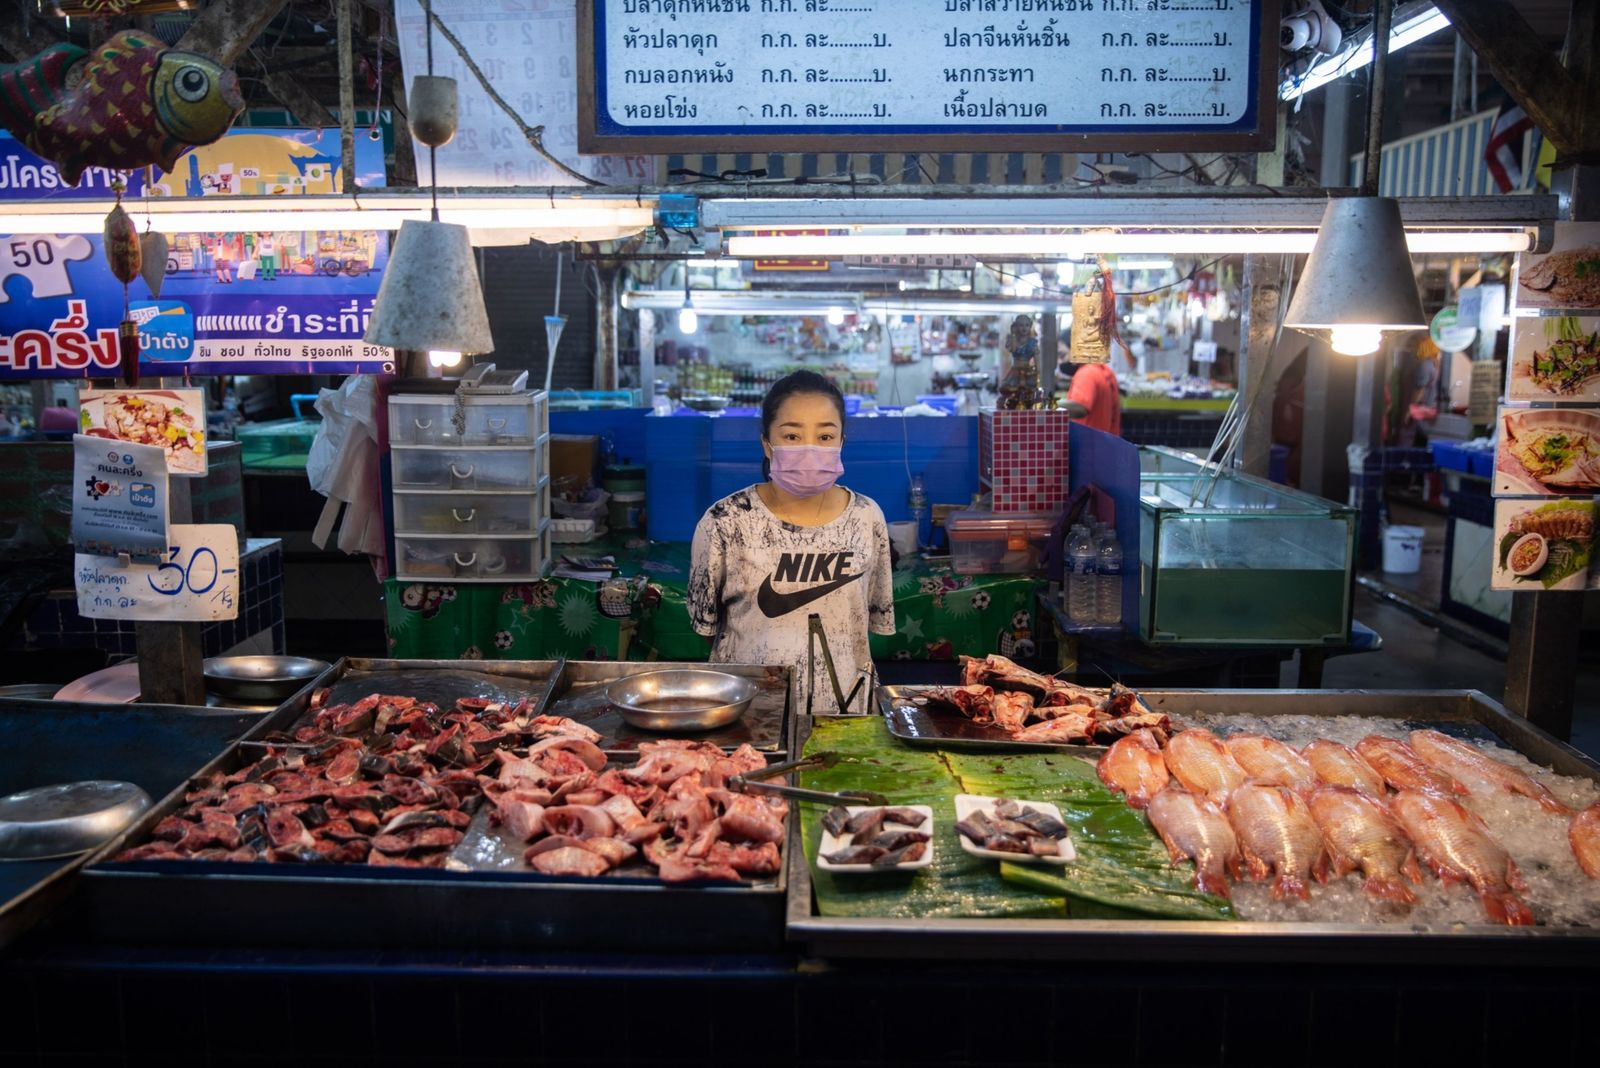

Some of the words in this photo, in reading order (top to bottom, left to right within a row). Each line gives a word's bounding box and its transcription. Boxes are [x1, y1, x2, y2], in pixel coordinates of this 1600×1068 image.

[623, 26, 718, 56] หัวปลาดุก
[761, 33, 798, 48] ก.ก.
[943, 18, 1071, 48] ปลาจีนหั่นชิ้น
[1101, 32, 1138, 47] ก.ก.
[624, 61, 734, 84] กบลอกหนัง
[761, 68, 798, 83] ก.ก.
[943, 67, 1034, 82] นกกระทา
[1101, 67, 1137, 82] ก.ก.
[624, 94, 697, 118] หอยโข่ง
[761, 103, 798, 118] ก.ก.
[943, 88, 1047, 117] เนื้อปลาบด
[1100, 103, 1136, 117] ก.ก.
[10, 239, 55, 268] 50
[254, 342, 291, 358] ทั่วไทย
[363, 346, 390, 358] 50%
[773, 551, 854, 583] NIKE
